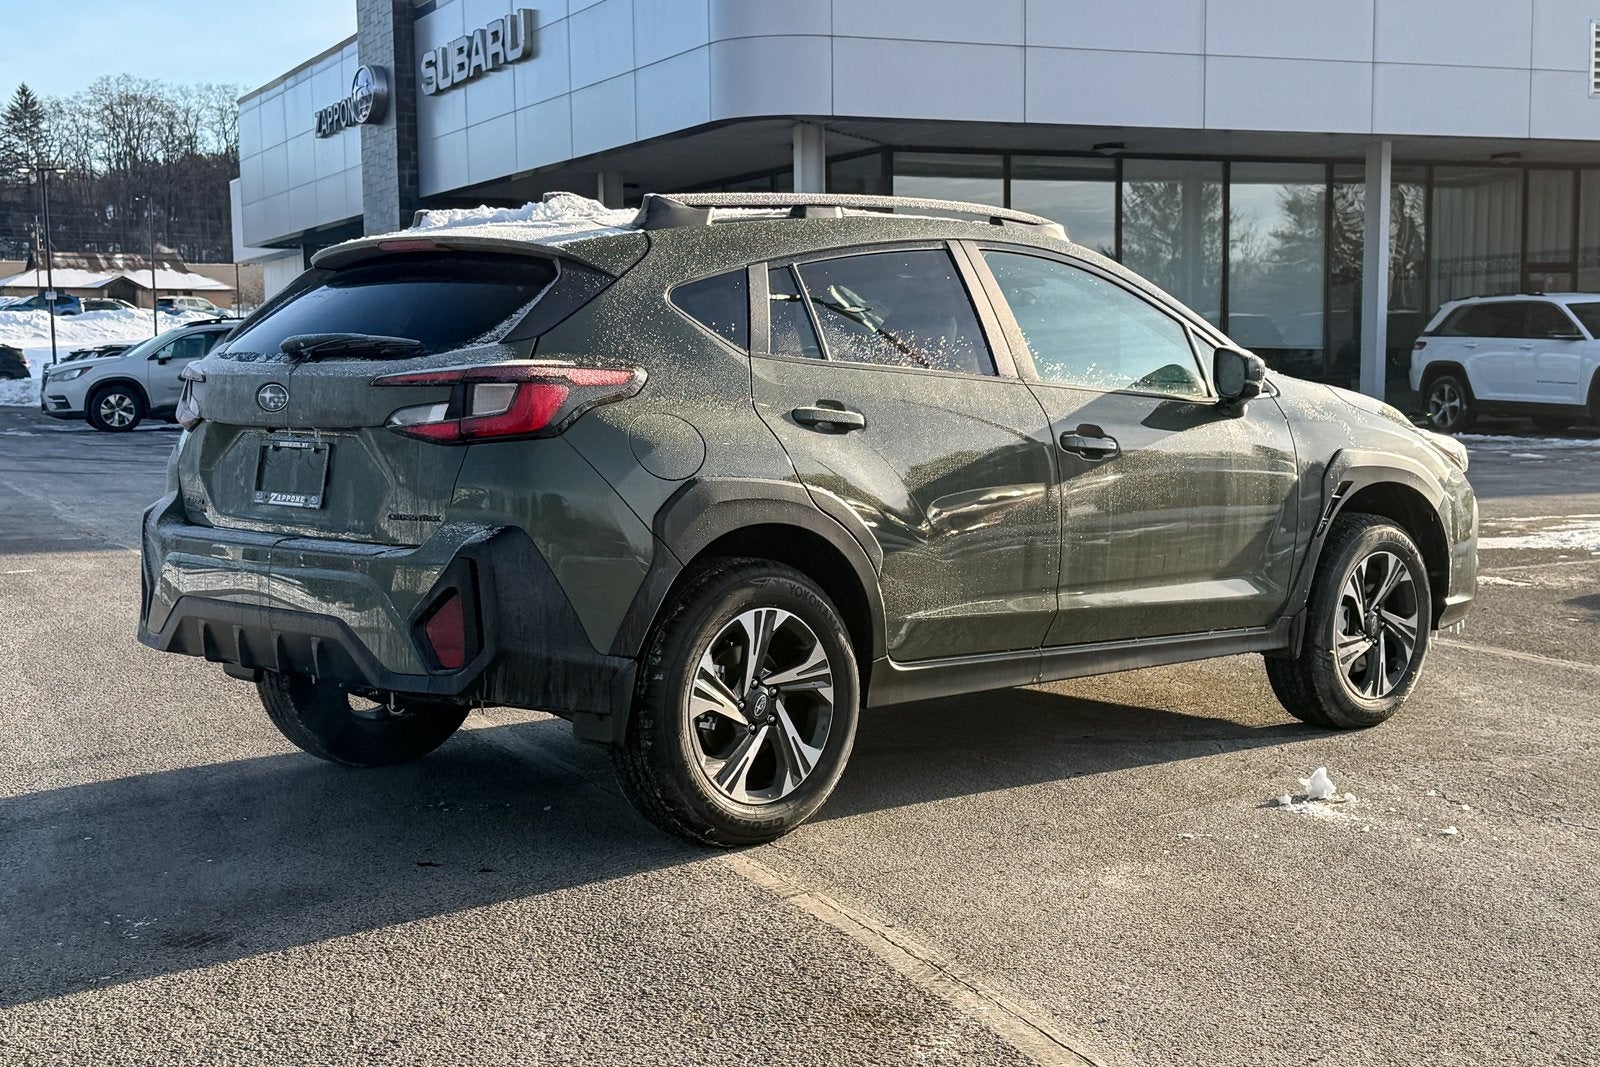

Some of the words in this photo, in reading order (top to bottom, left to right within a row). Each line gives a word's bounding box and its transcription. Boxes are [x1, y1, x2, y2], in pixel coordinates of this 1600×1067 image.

[421, 8, 532, 96] SUBARU
[314, 97, 356, 139] ZAPPON
[268, 492, 305, 505] ZAPPONE
